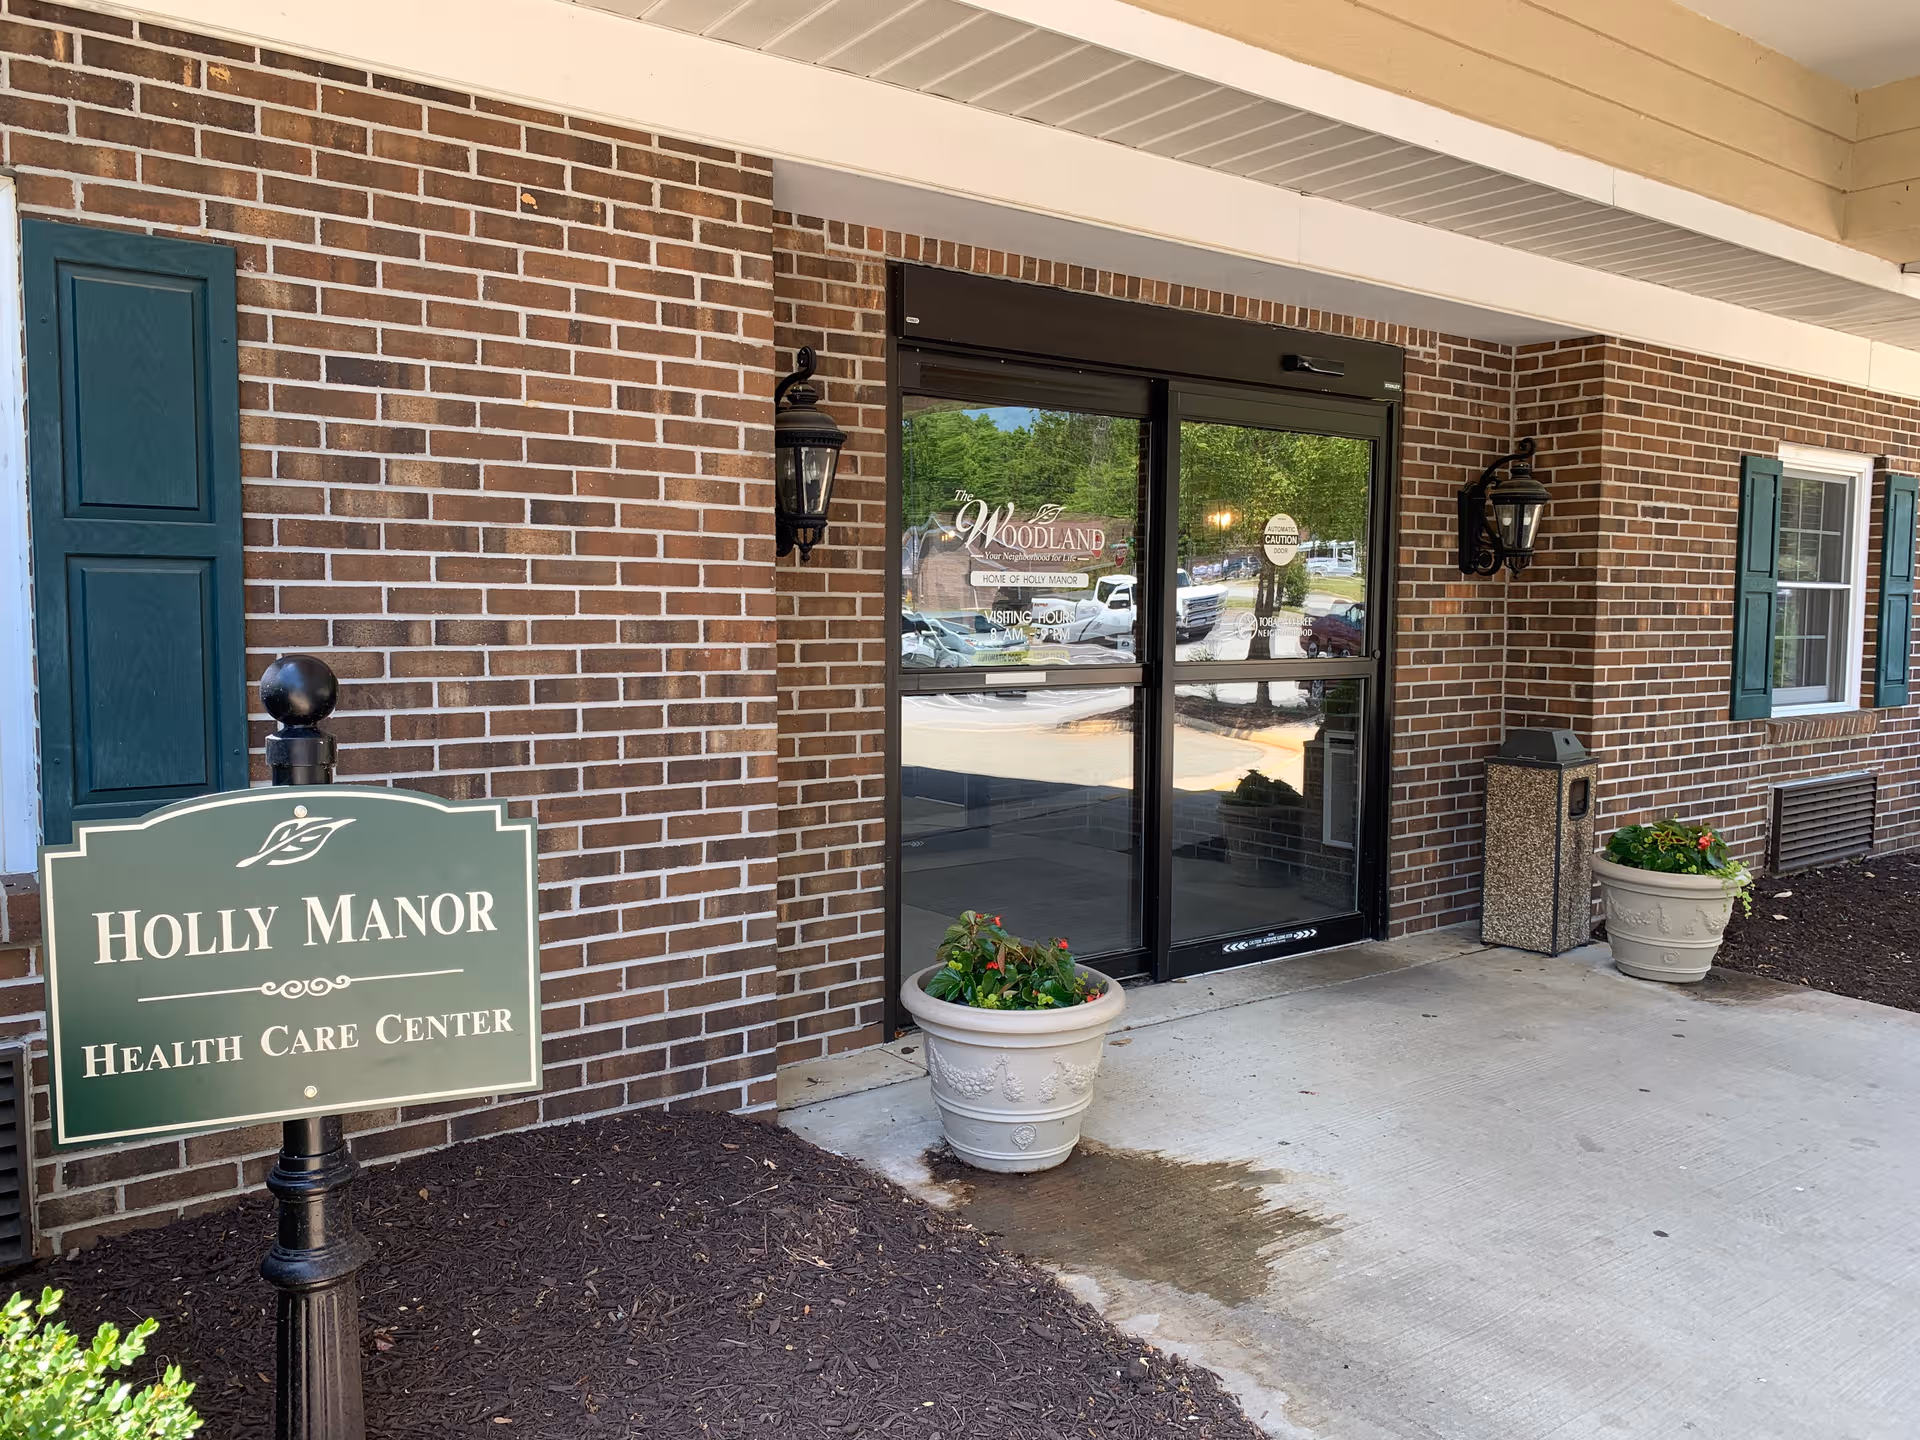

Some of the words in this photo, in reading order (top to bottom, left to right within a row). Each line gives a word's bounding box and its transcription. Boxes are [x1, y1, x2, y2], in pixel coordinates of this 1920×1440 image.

[954, 490, 974, 502] The
[955, 499, 1105, 551] WOODLAND
[1265, 535, 1298, 544] CAUTION
[984, 551, 1002, 560] Your
[1002, 552, 1050, 562] Neighborhood
[1051, 554, 1062, 562] for
[982, 574, 1006, 584] HOME
[1009, 575, 1020, 584] OF
[1023, 575, 1046, 584] HOLLY
[1048, 576, 1078, 585] MANOR
[984, 610, 1033, 624] VISITING
[1038, 611, 1076, 624] HOURS
[990, 627, 997, 640] 8
[1002, 628, 1024, 640] AM
[1040, 628, 1049, 640] 9
[1257, 628, 1313, 637] NEIGOOD
[91, 905, 279, 966] HOLLY
[300, 890, 498, 947] MANOR
[81, 1034, 243, 1078] HEALTH
[259, 1023, 359, 1057] CARE
[375, 1008, 514, 1045] CENTER
